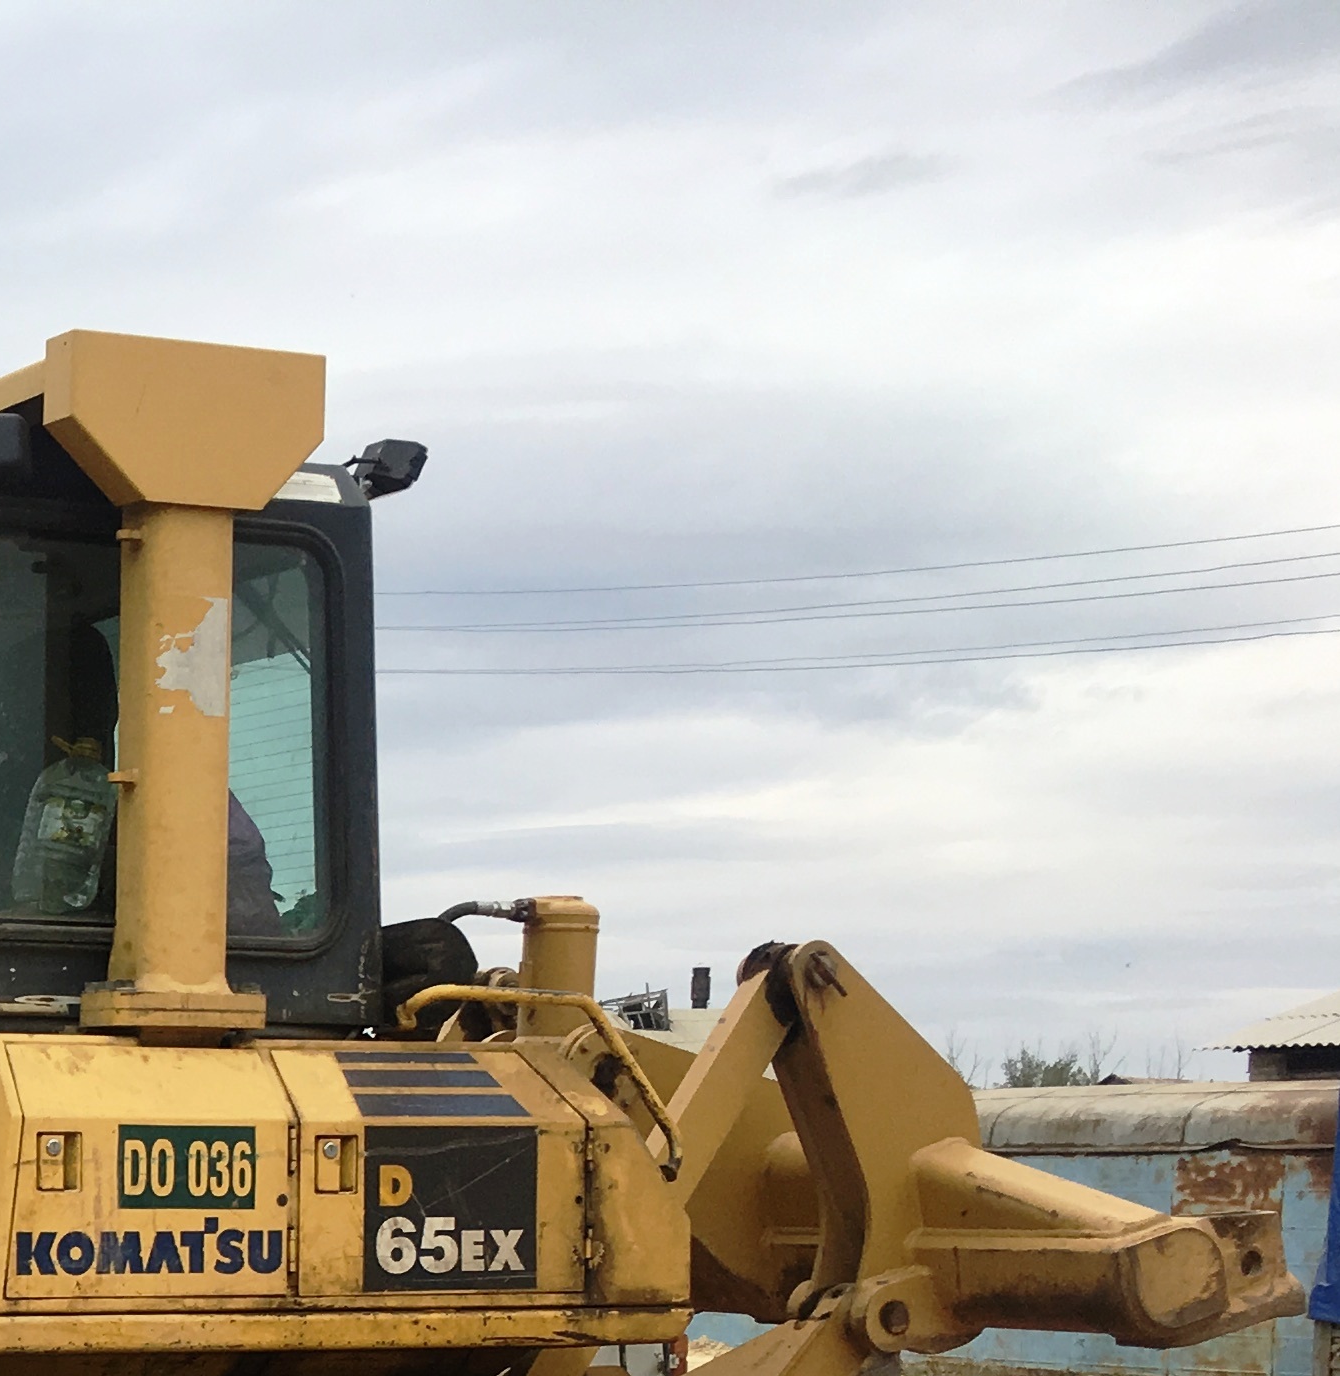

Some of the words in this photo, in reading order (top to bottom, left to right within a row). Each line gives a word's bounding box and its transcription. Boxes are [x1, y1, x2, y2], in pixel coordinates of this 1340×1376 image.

[187, 1140, 252, 1197] 036
[379, 1164, 413, 1207] D
[16, 1216, 283, 1275] KOMATSU
